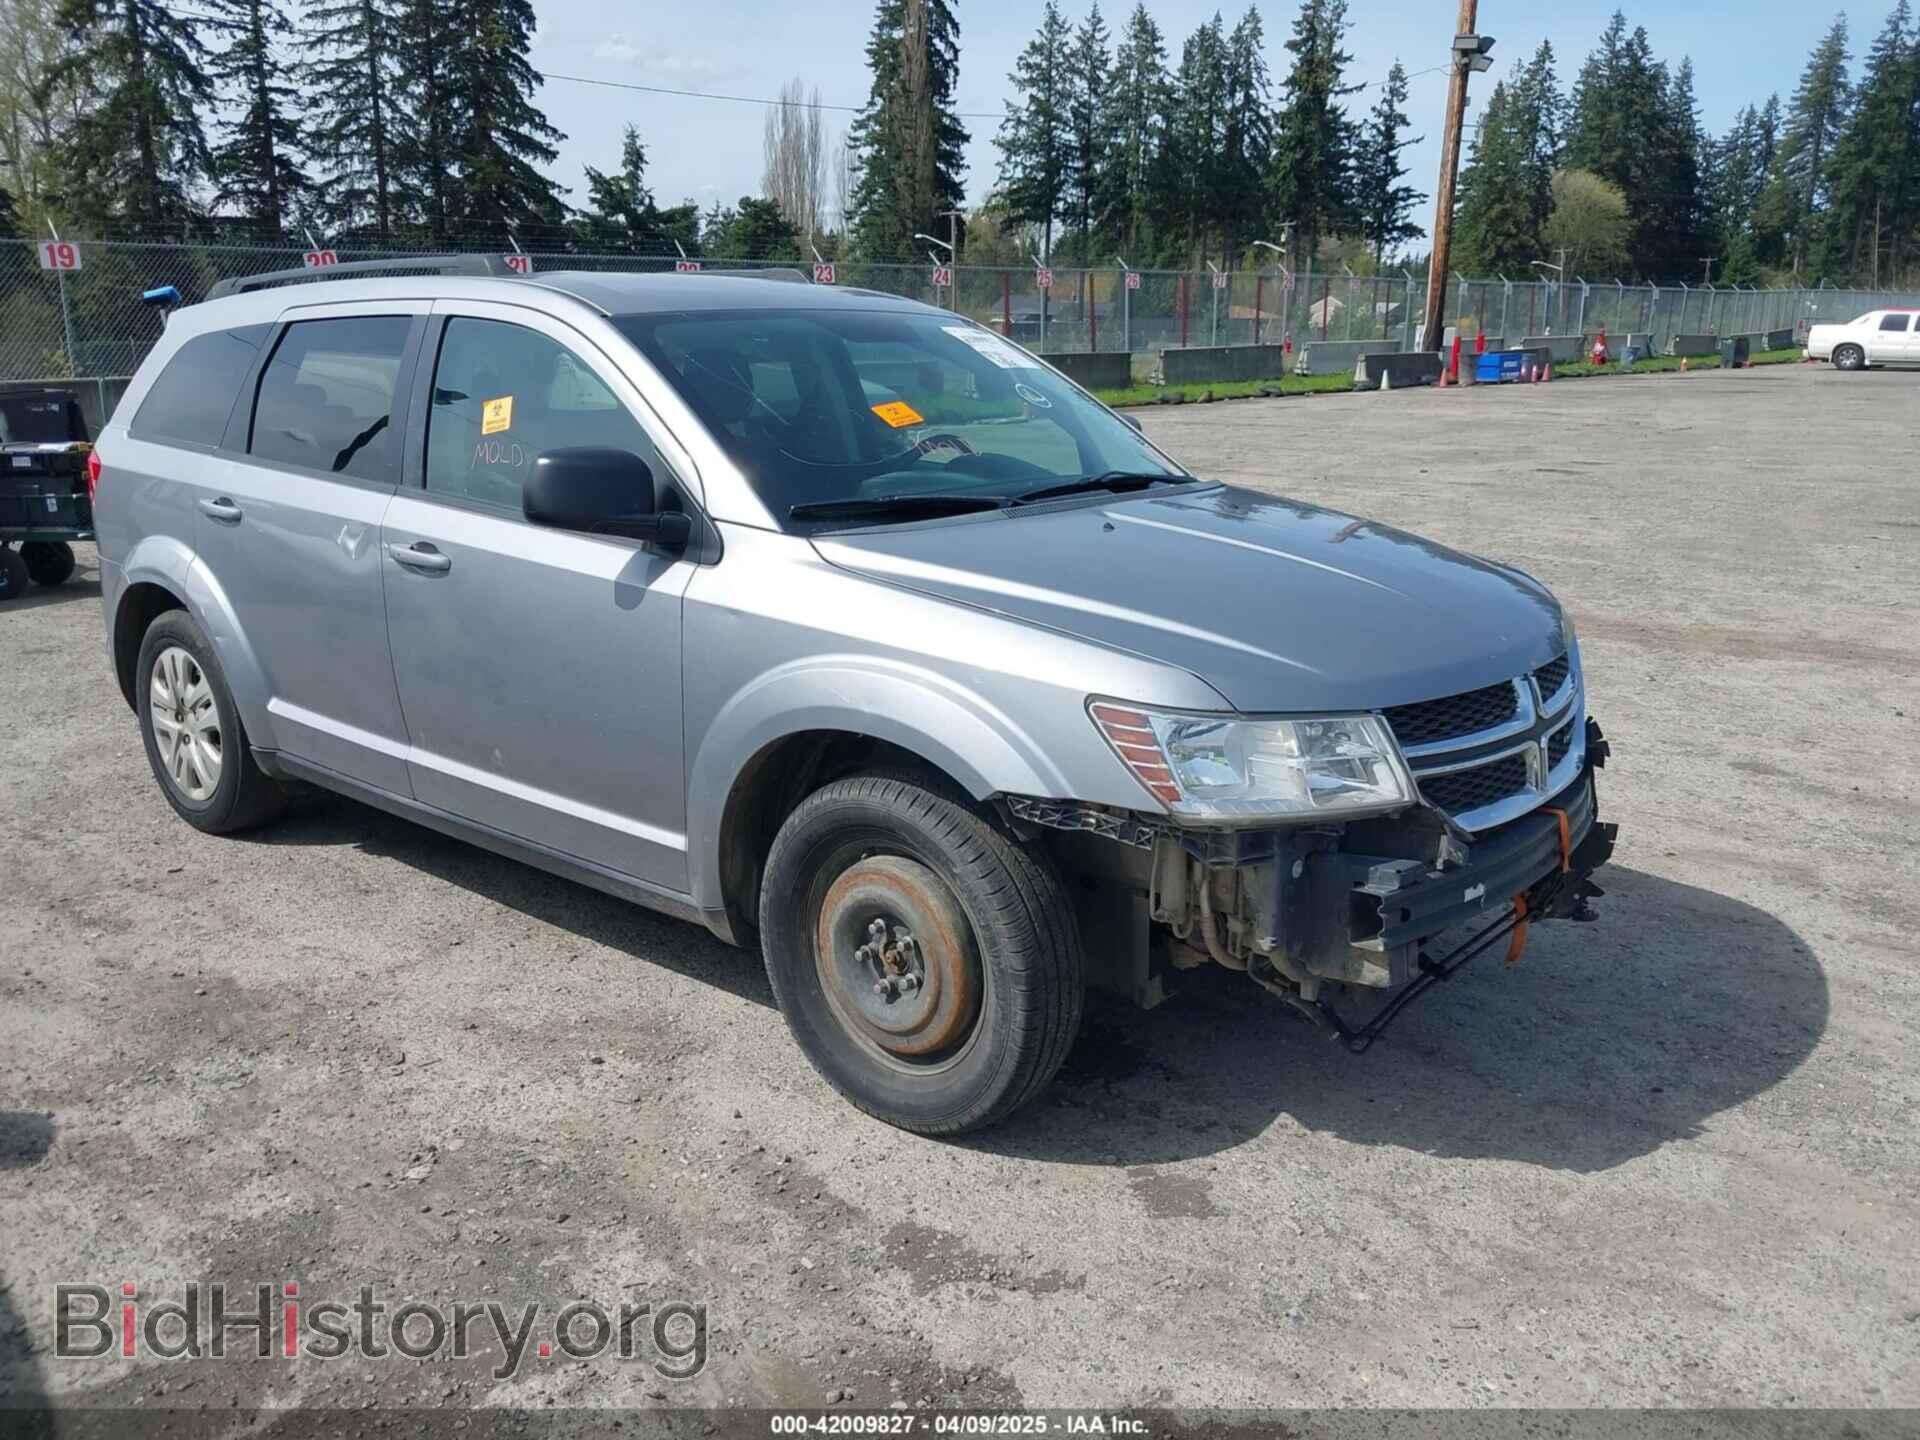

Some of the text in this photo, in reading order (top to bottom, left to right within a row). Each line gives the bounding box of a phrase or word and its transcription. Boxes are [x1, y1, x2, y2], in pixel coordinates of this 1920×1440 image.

[46, 243, 75, 268] 19
[815, 265, 833, 282] 23
[934, 267, 950, 284] 24
[1039, 270, 1052, 288] 25
[1126, 273, 1140, 288] 26
